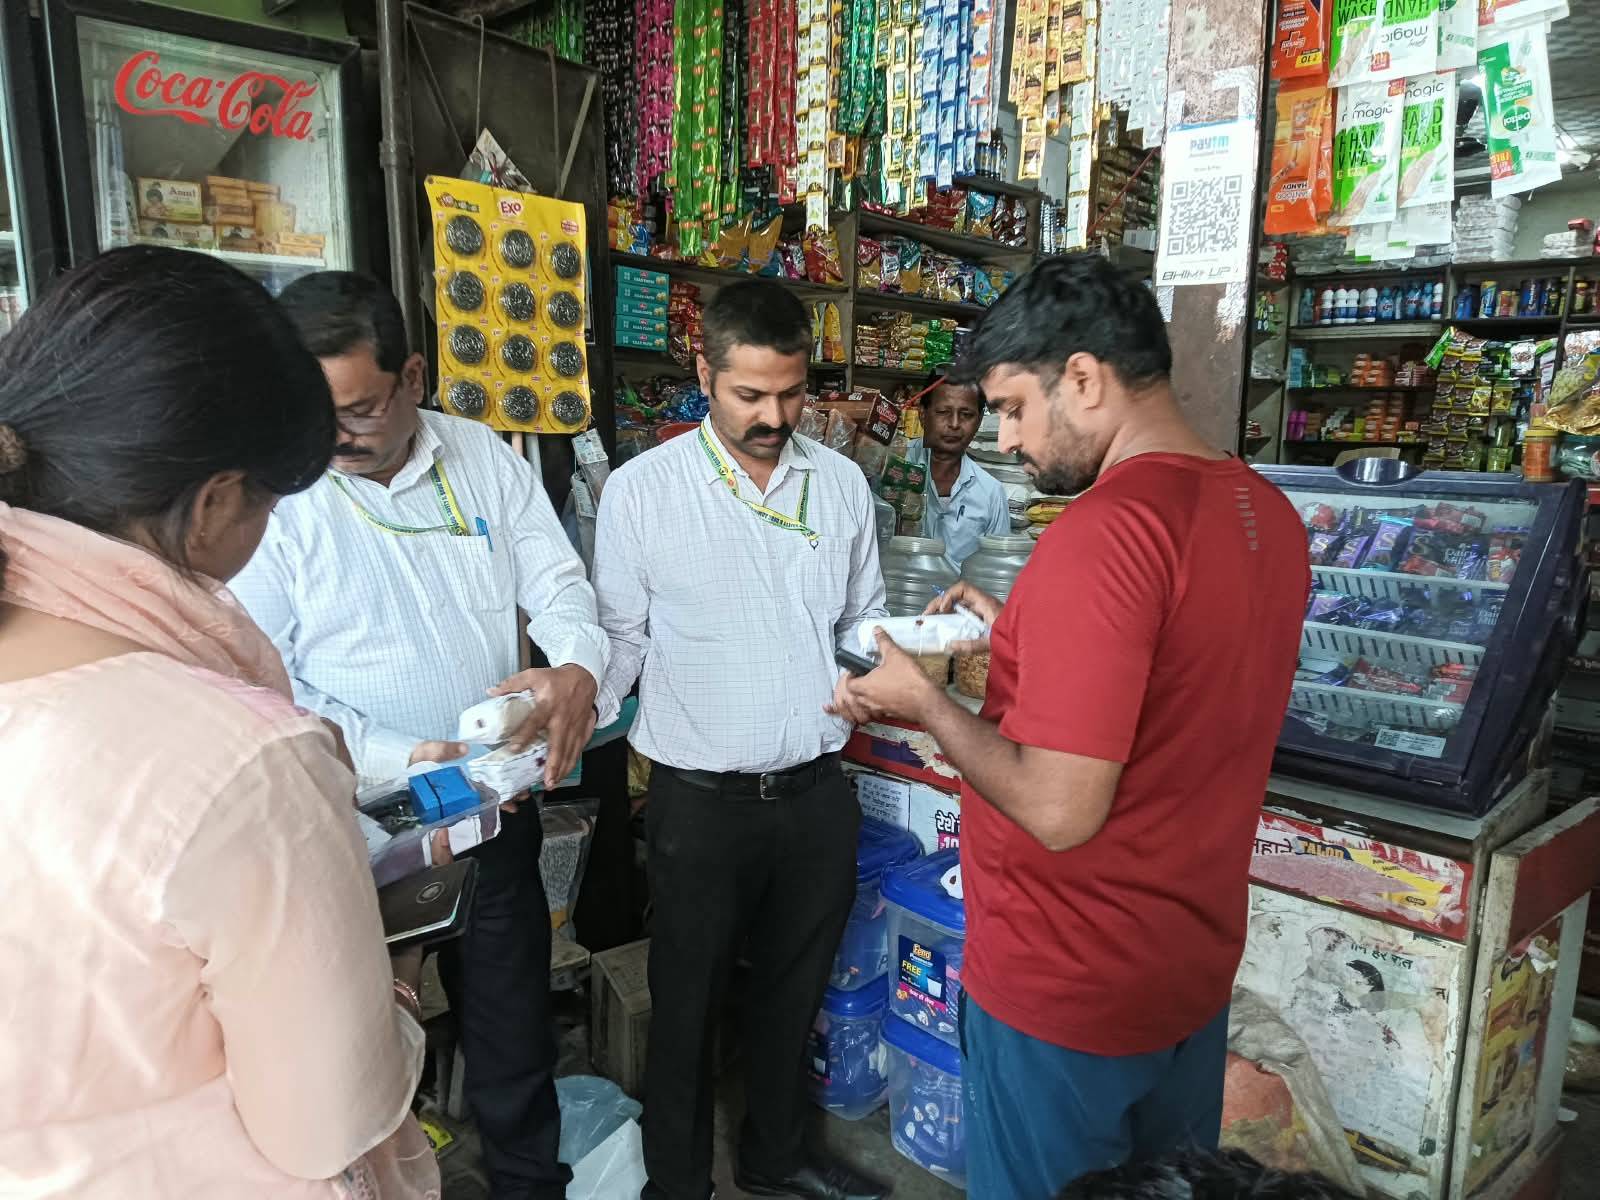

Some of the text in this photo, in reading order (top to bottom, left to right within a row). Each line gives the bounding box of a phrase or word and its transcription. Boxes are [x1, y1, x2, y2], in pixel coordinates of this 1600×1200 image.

[1381, 26, 1428, 43] magic
[114, 51, 318, 141] Coca-Cola
[1352, 102, 1393, 119] magic
[1503, 111, 1530, 126] Dettol
[1282, 182, 1308, 190] HANDY
[1162, 269, 1199, 281] BHIM
[902, 960, 922, 976] FREE
